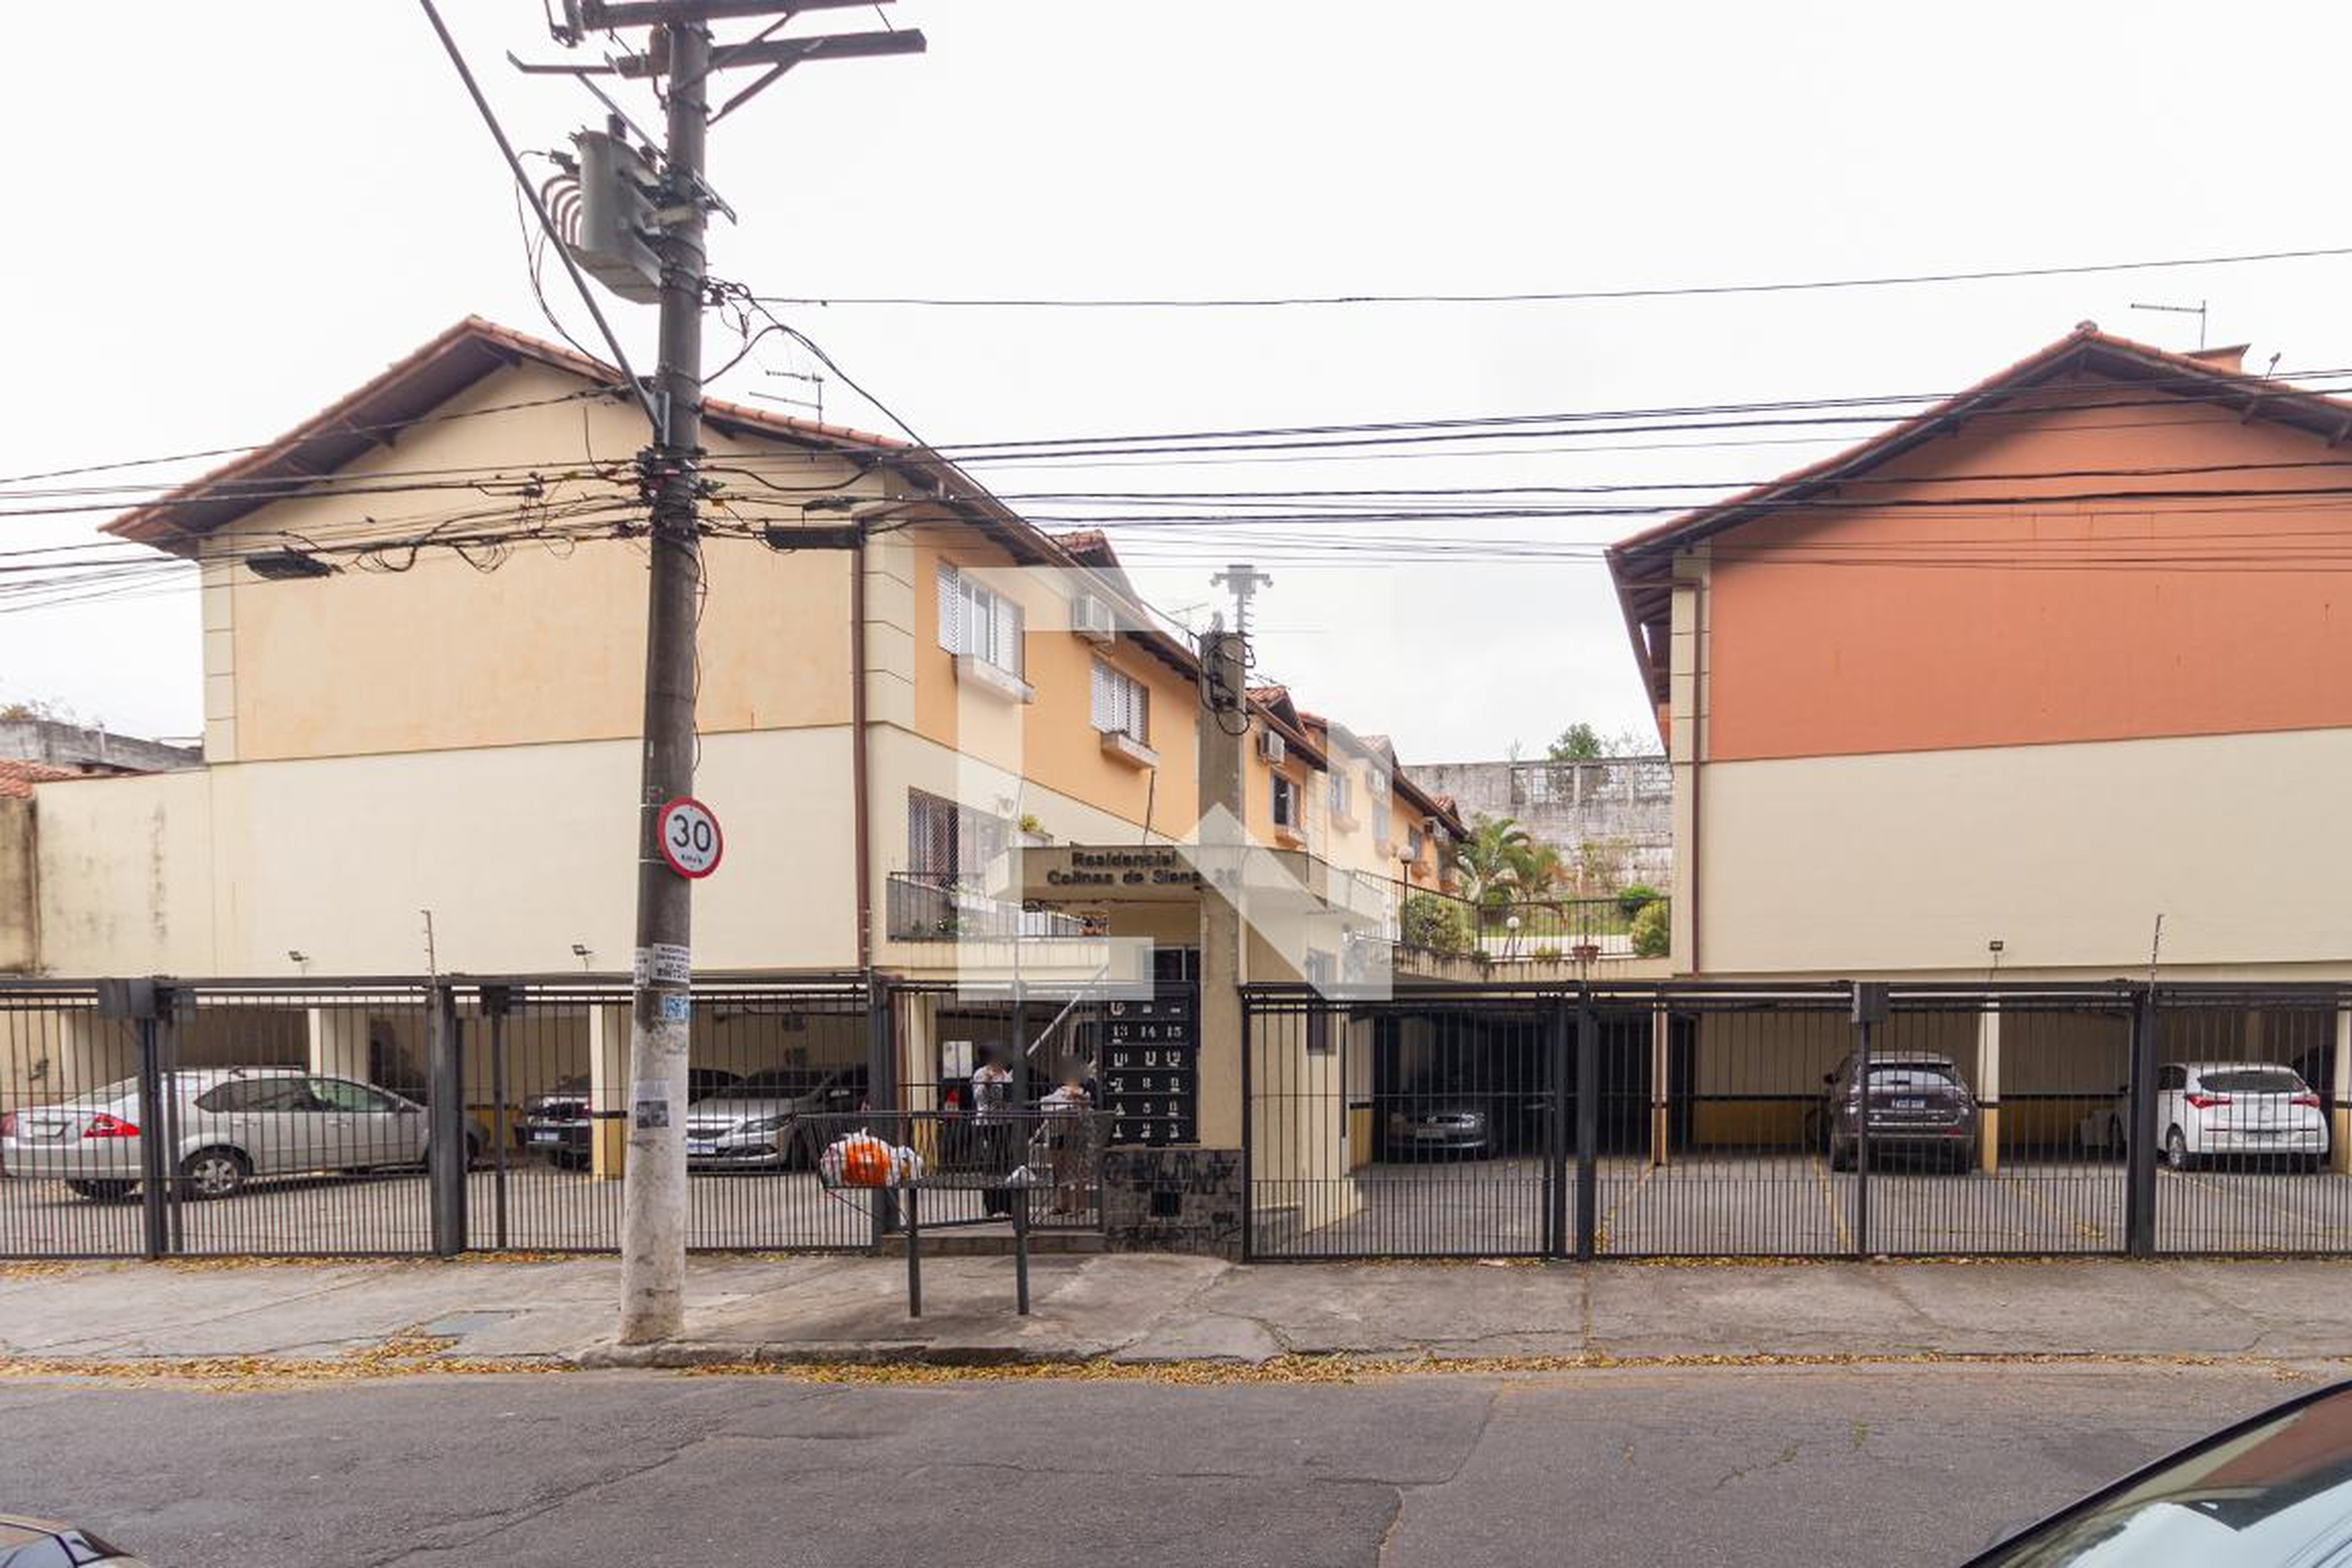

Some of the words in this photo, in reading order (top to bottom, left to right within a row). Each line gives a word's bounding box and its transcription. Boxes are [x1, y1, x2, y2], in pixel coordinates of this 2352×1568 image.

[673, 814, 711, 852] 30
[1072, 850, 1177, 867] Residencial
[1047, 869, 1114, 884] Colinas
[1122, 869, 1144, 884] de
[1152, 869, 1202, 884] Siena
[1140, 1025, 1156, 1038] 14
[1167, 1025, 1182, 1038] 15
